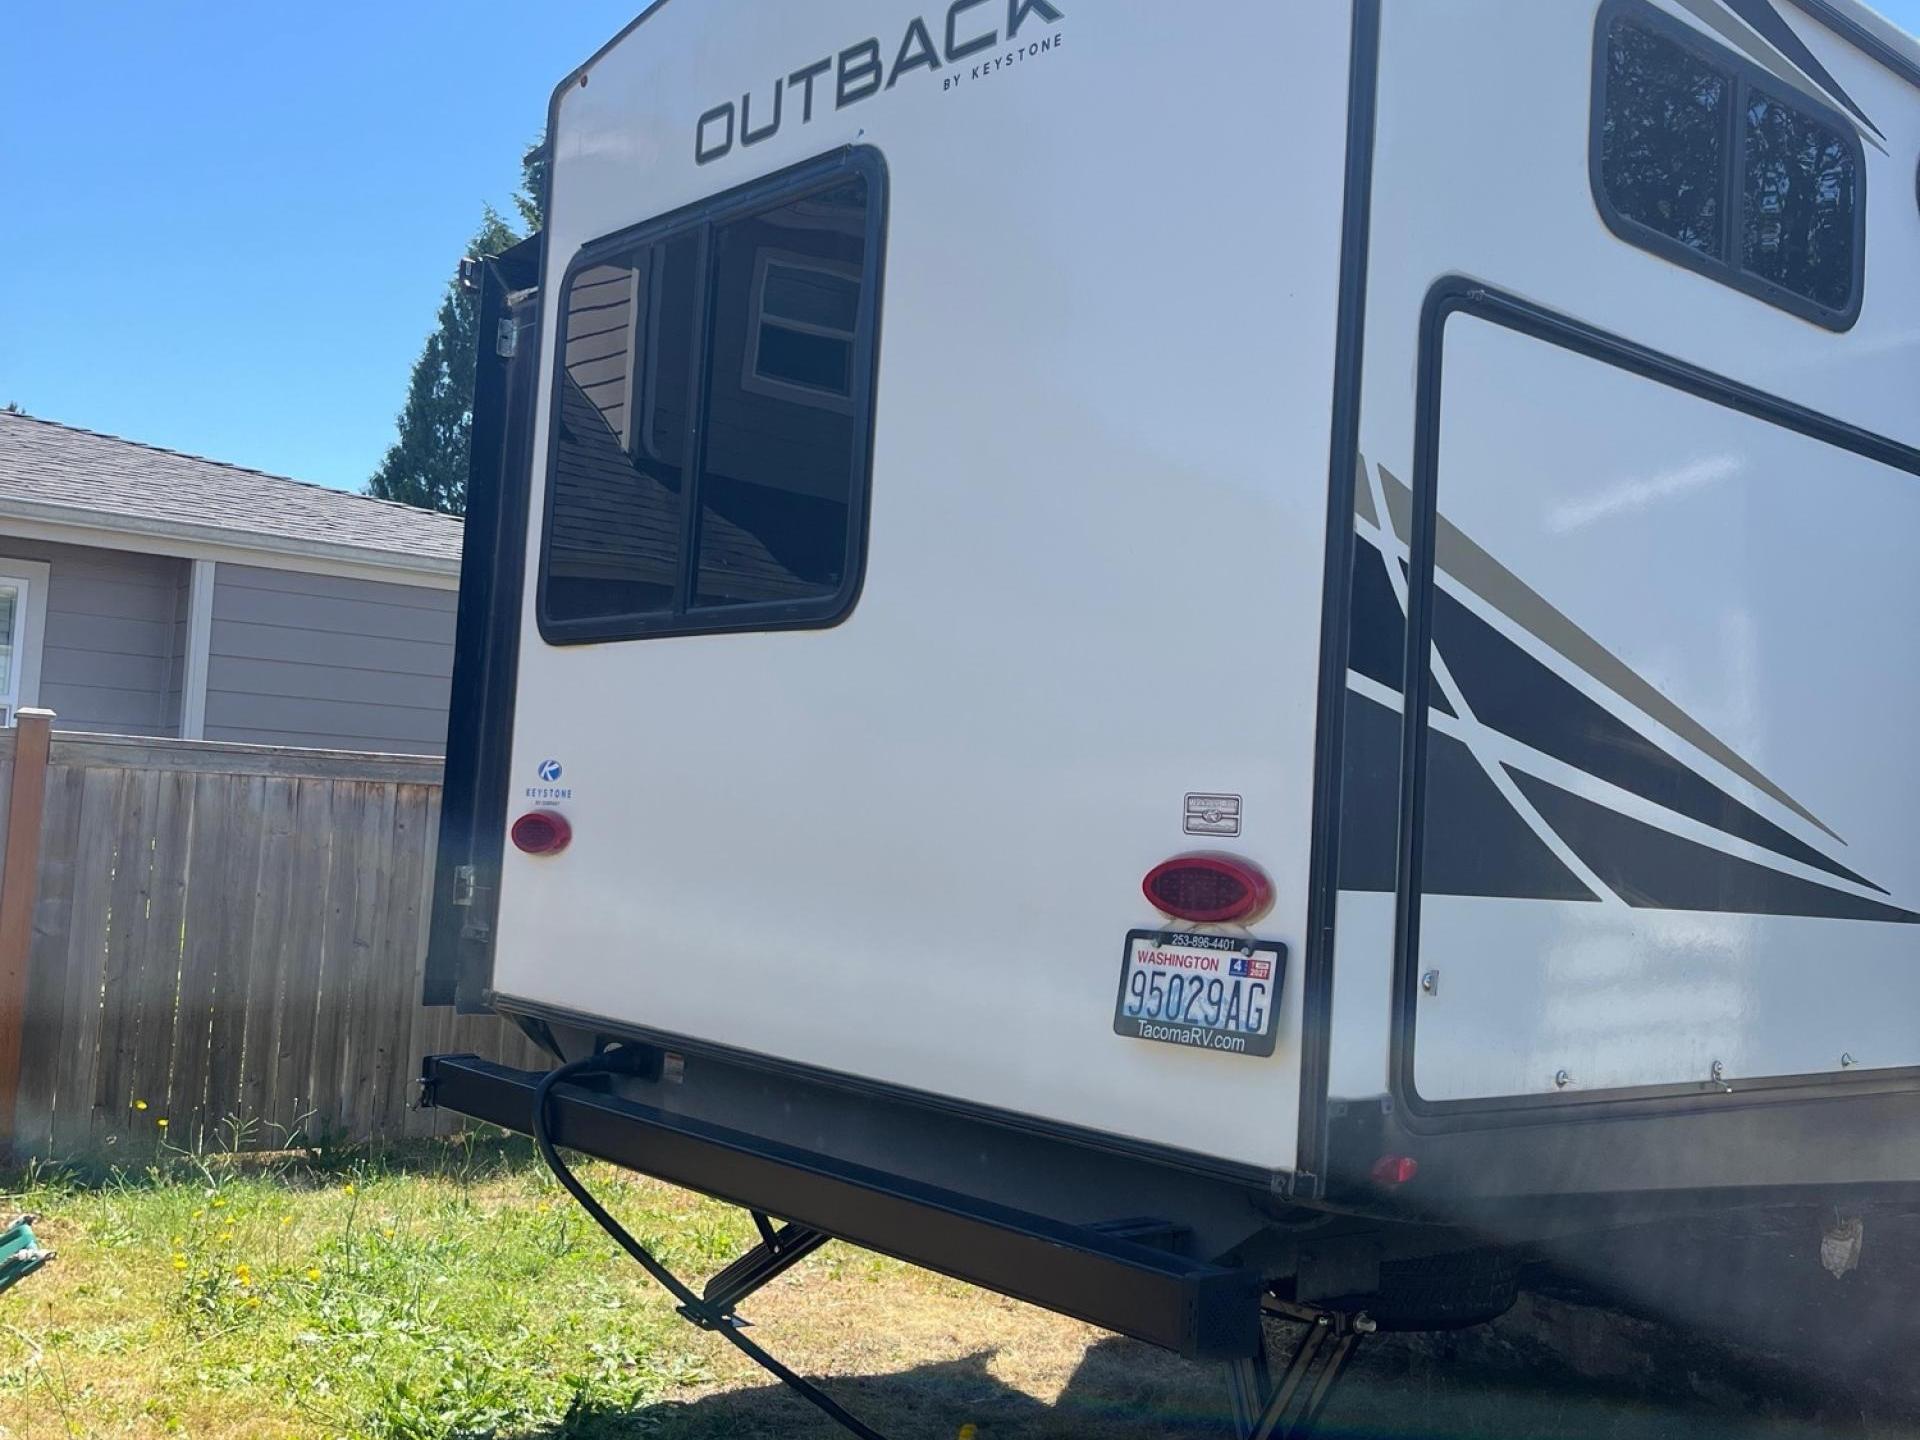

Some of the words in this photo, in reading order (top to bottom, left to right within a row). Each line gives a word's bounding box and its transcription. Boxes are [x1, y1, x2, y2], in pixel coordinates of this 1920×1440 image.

[943, 74, 961, 91] BY
[972, 33, 1062, 80] KEYSTONE
[695, 0, 1064, 166] OUTBACK
[526, 787, 571, 799] KEYSTONE
[1138, 950, 1220, 972] WASHINGTON
[1233, 960, 1242, 971] 4
[1128, 970, 1266, 1033] 95029AG
[1138, 1019, 1245, 1052] TacomaRV.com
